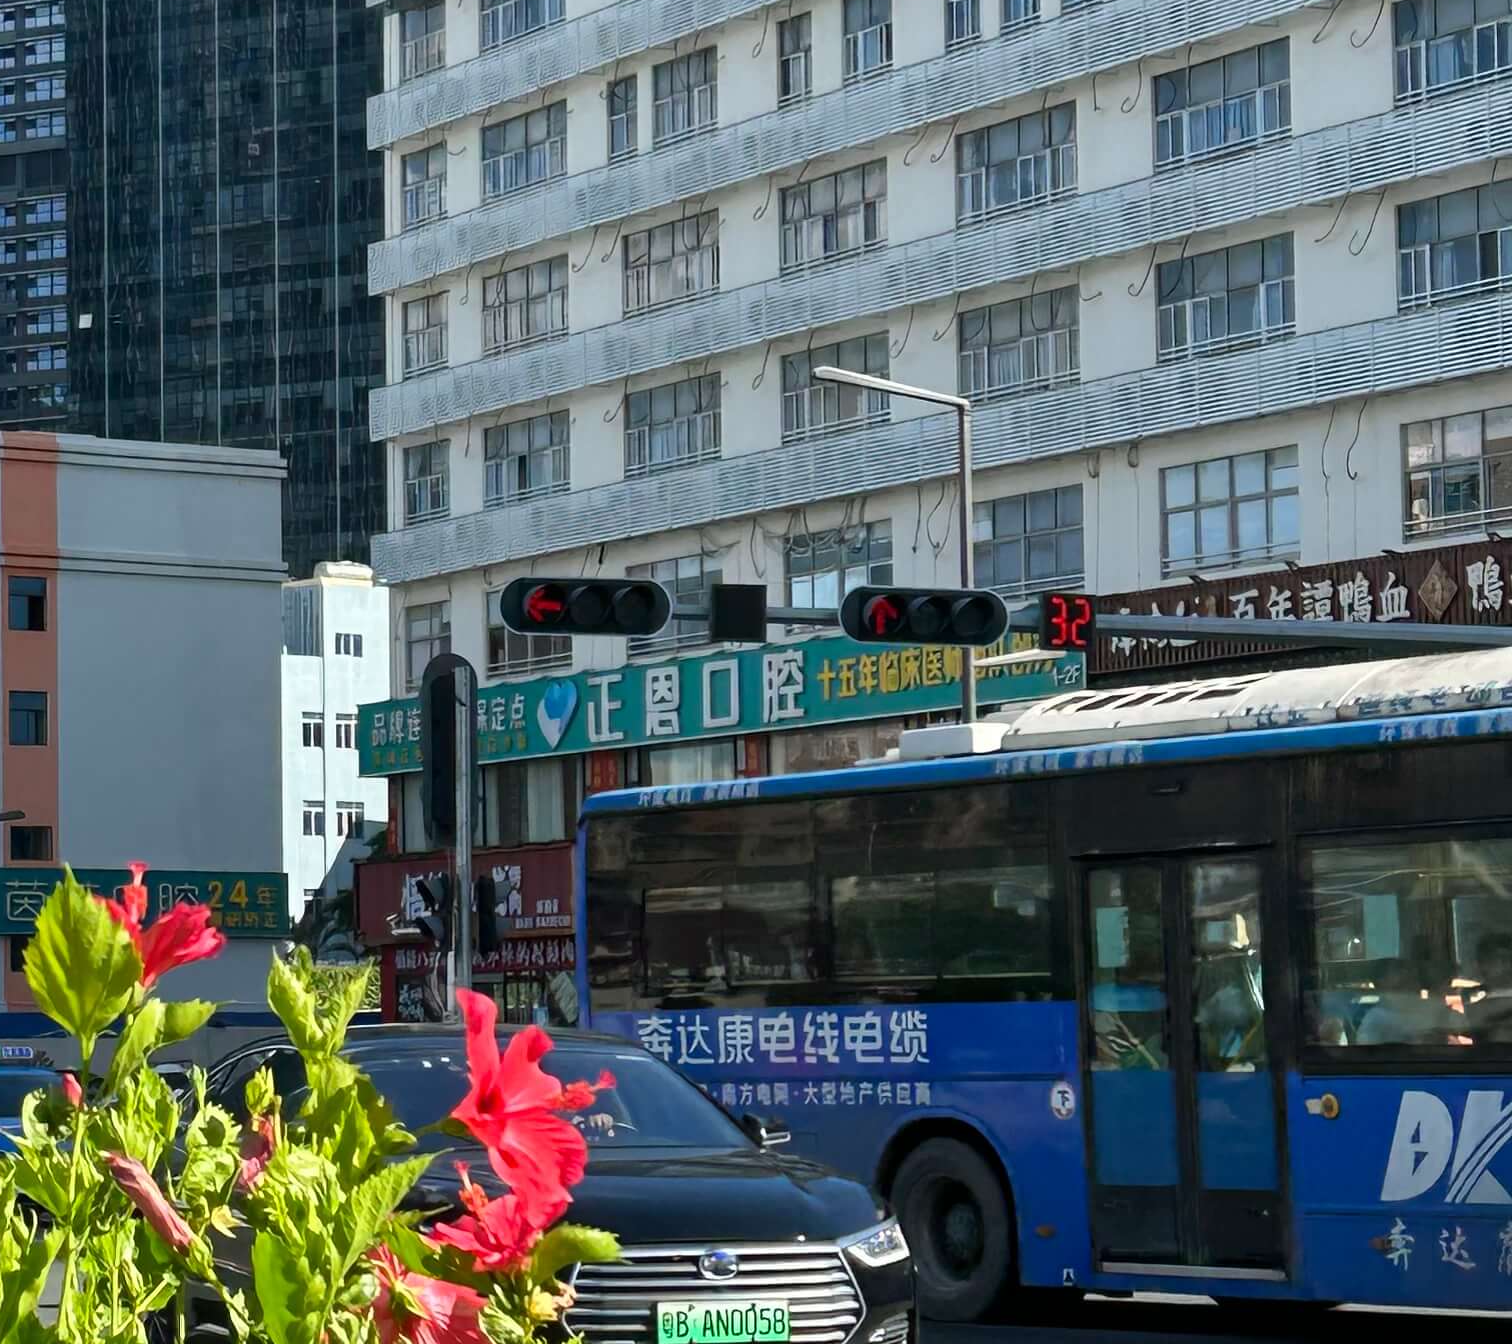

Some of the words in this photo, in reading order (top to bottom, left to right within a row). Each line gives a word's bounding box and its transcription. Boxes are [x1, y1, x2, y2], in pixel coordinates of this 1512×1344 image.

[1051, 594, 1091, 646] 32
[586, 649, 805, 743] 正恩口腔
